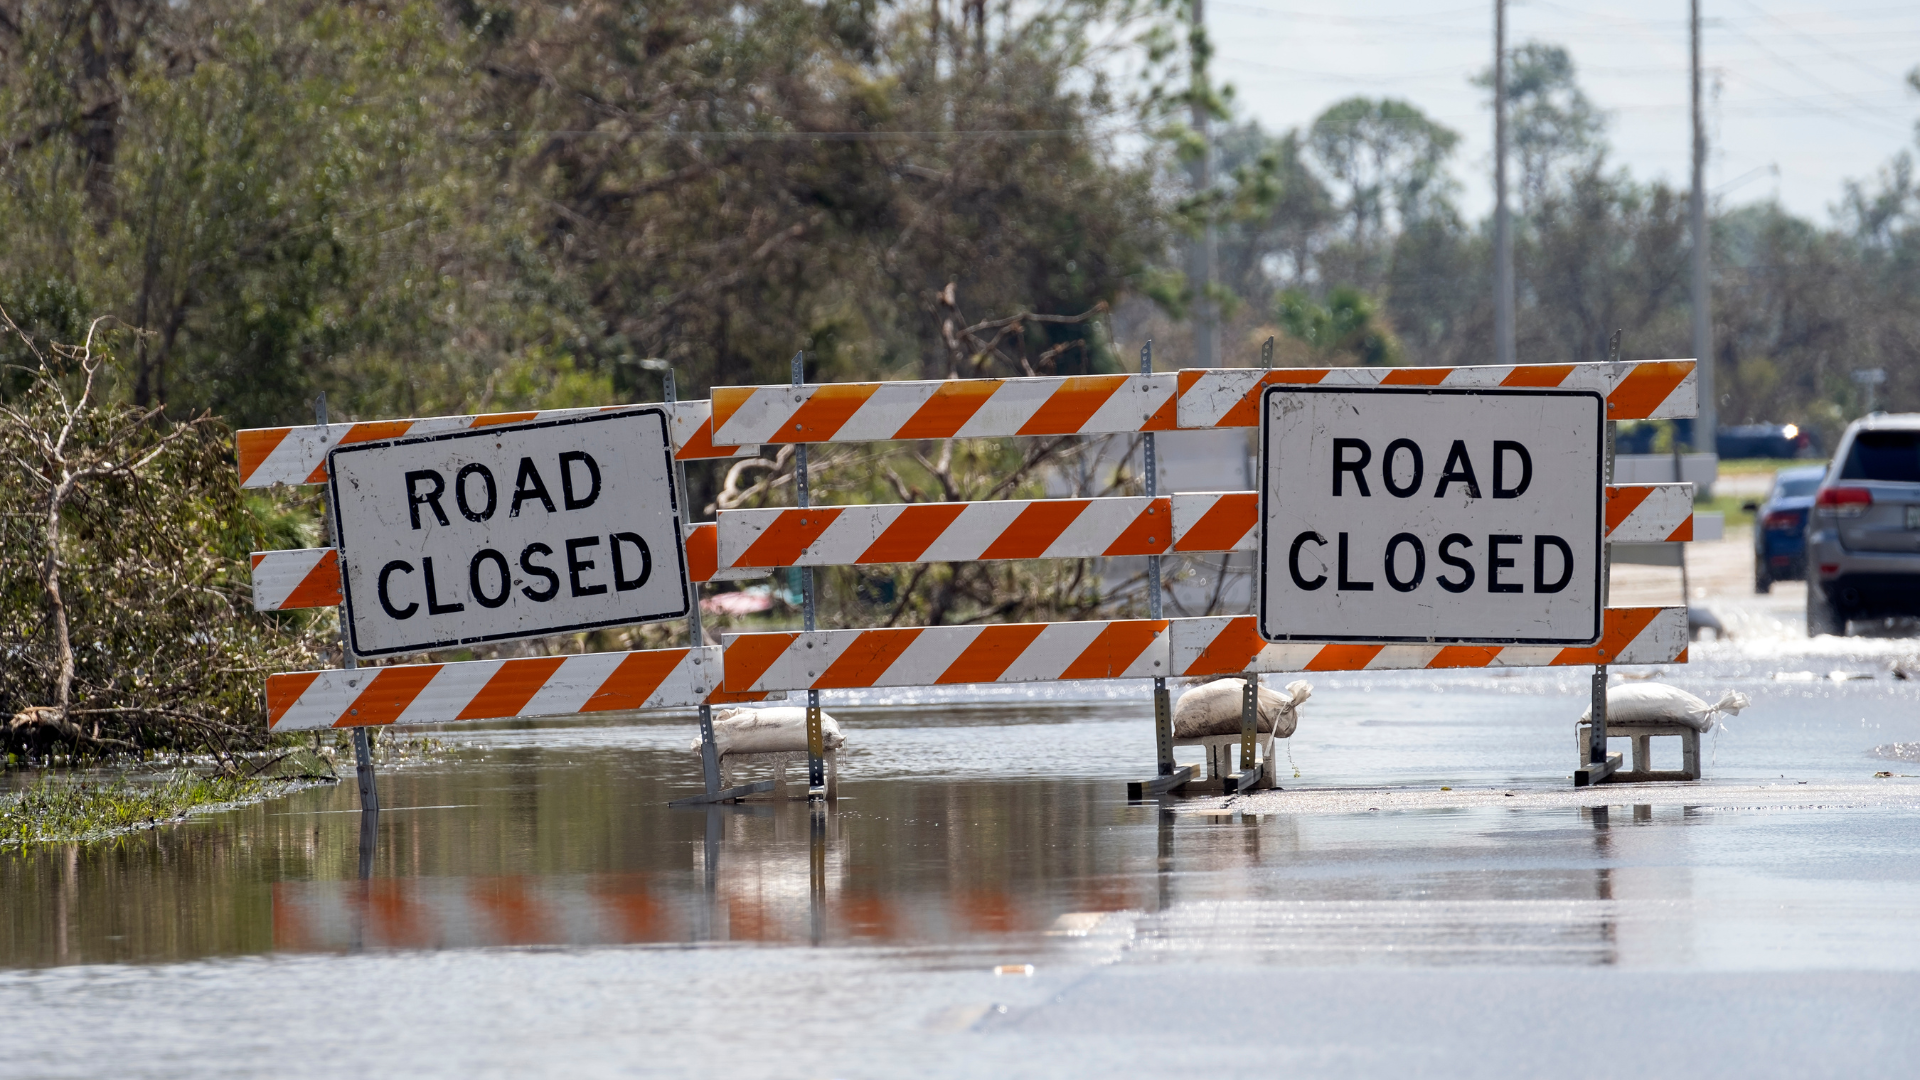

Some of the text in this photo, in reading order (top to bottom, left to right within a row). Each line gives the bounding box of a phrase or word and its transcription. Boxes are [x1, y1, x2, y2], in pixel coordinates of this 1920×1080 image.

[405, 451, 602, 531] ROAD
[1332, 438, 1532, 499] ROAD
[378, 532, 653, 621] CLOSED
[1289, 531, 1575, 594] CLOSED
